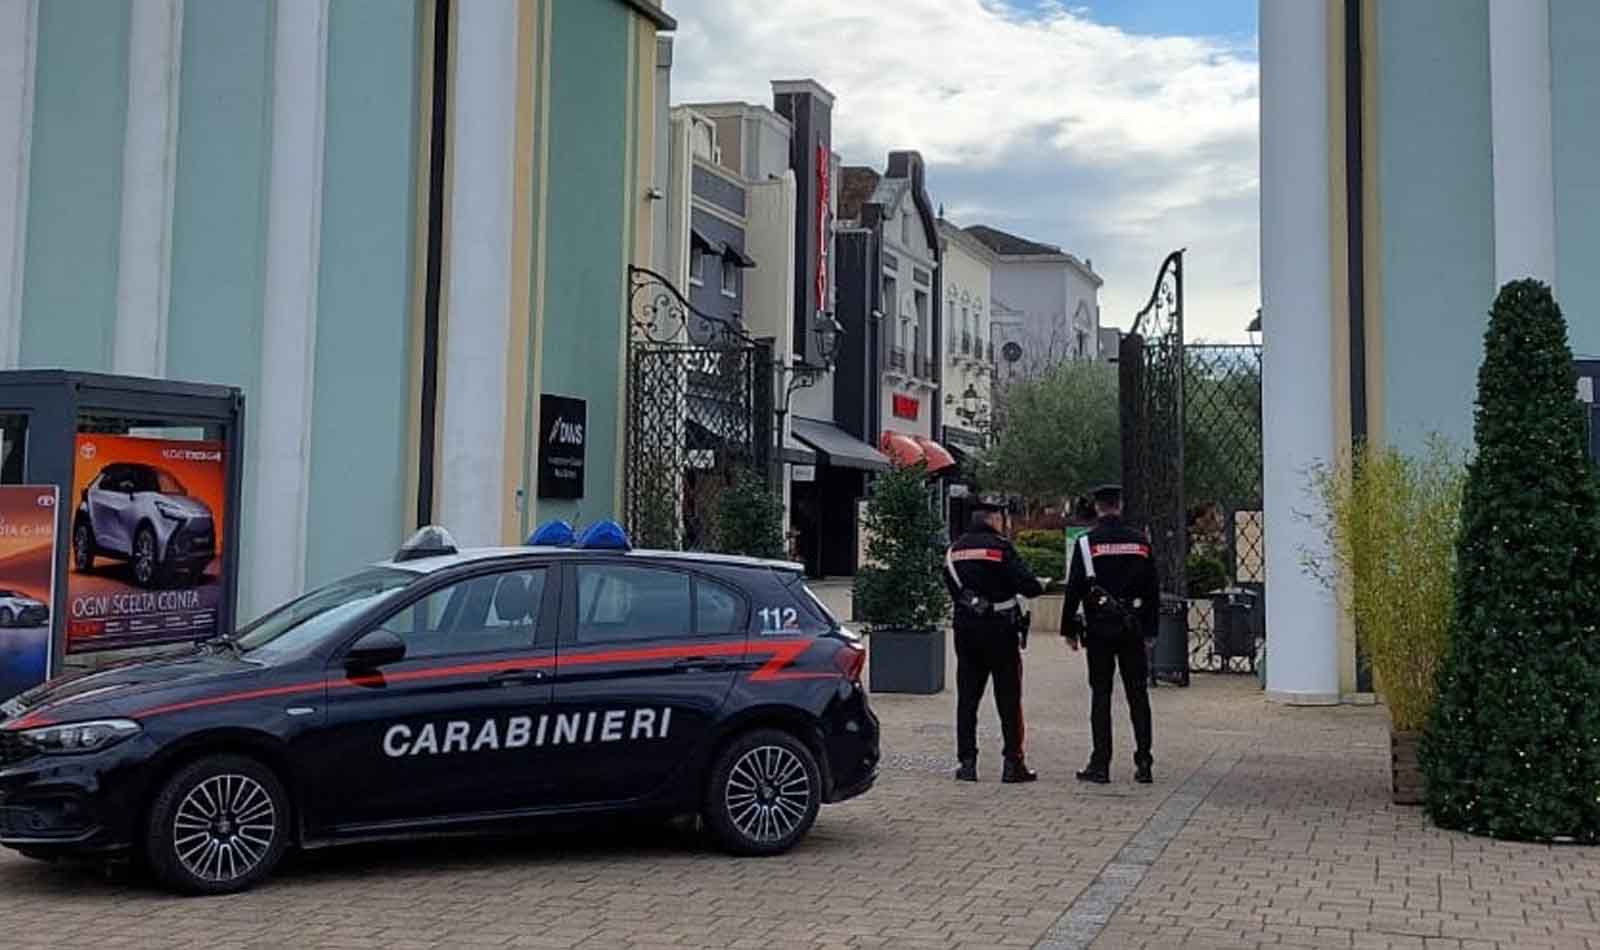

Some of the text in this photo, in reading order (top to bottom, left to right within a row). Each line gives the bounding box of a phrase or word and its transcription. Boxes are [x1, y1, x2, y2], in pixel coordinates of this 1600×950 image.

[72, 590, 200, 617] OGNI SCELTA CONTA
[757, 607, 800, 629] 112
[383, 707, 671, 757] CARABINIERI
